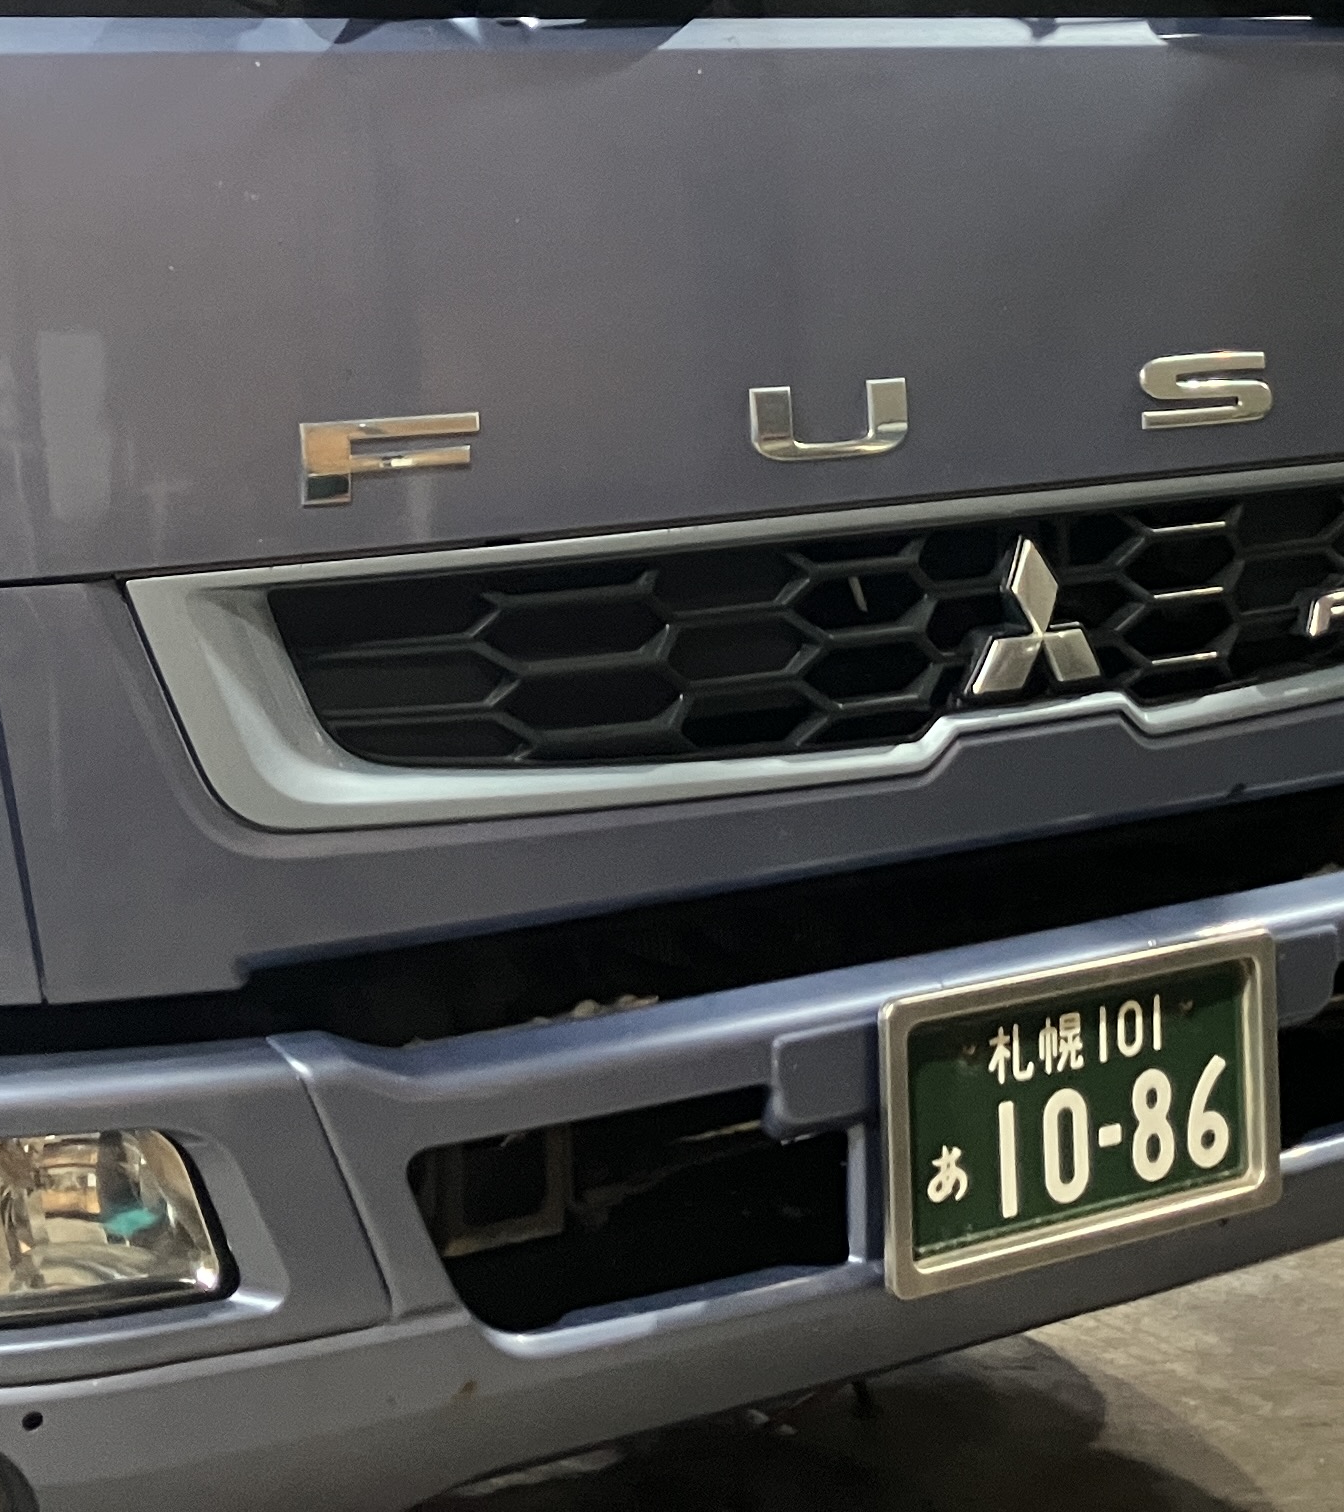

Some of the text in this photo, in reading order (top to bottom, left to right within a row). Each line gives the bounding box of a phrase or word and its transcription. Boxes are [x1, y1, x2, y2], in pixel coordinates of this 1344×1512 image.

[987, 994, 1163, 1085] 札幌 101
[925, 1054, 1230, 1219] あ 10-86
